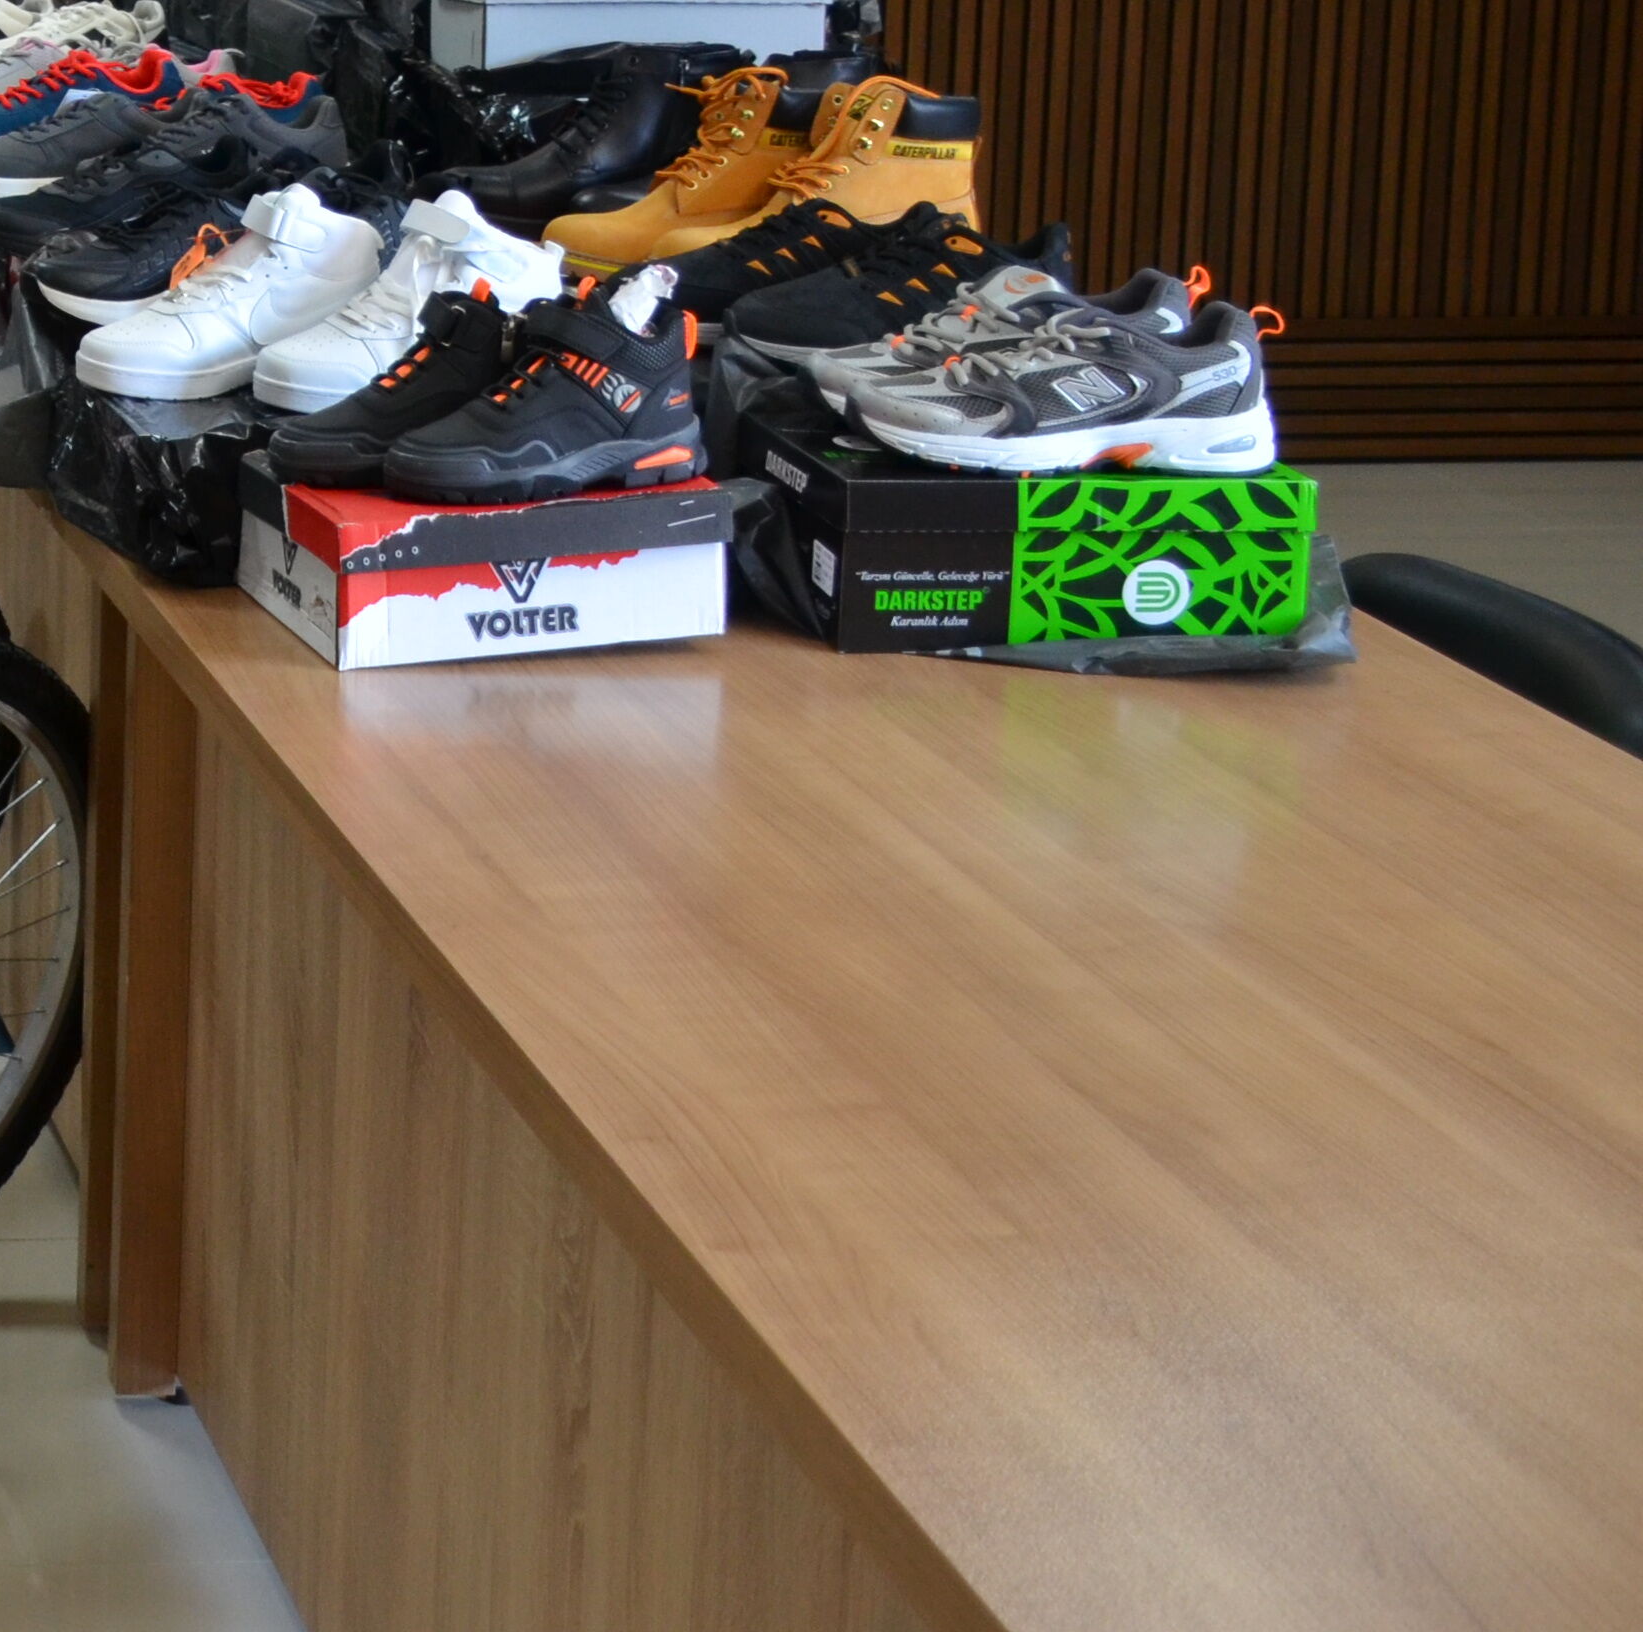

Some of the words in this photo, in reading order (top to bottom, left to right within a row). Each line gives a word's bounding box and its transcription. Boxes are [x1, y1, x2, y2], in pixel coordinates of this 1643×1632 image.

[892, 144, 957, 160] CATERPILLAR
[1211, 366, 1238, 382] 530
[765, 450, 808, 494] DARKSTEP
[875, 590, 983, 611] DARKSTEP
[466, 606, 578, 641] VOLTER
